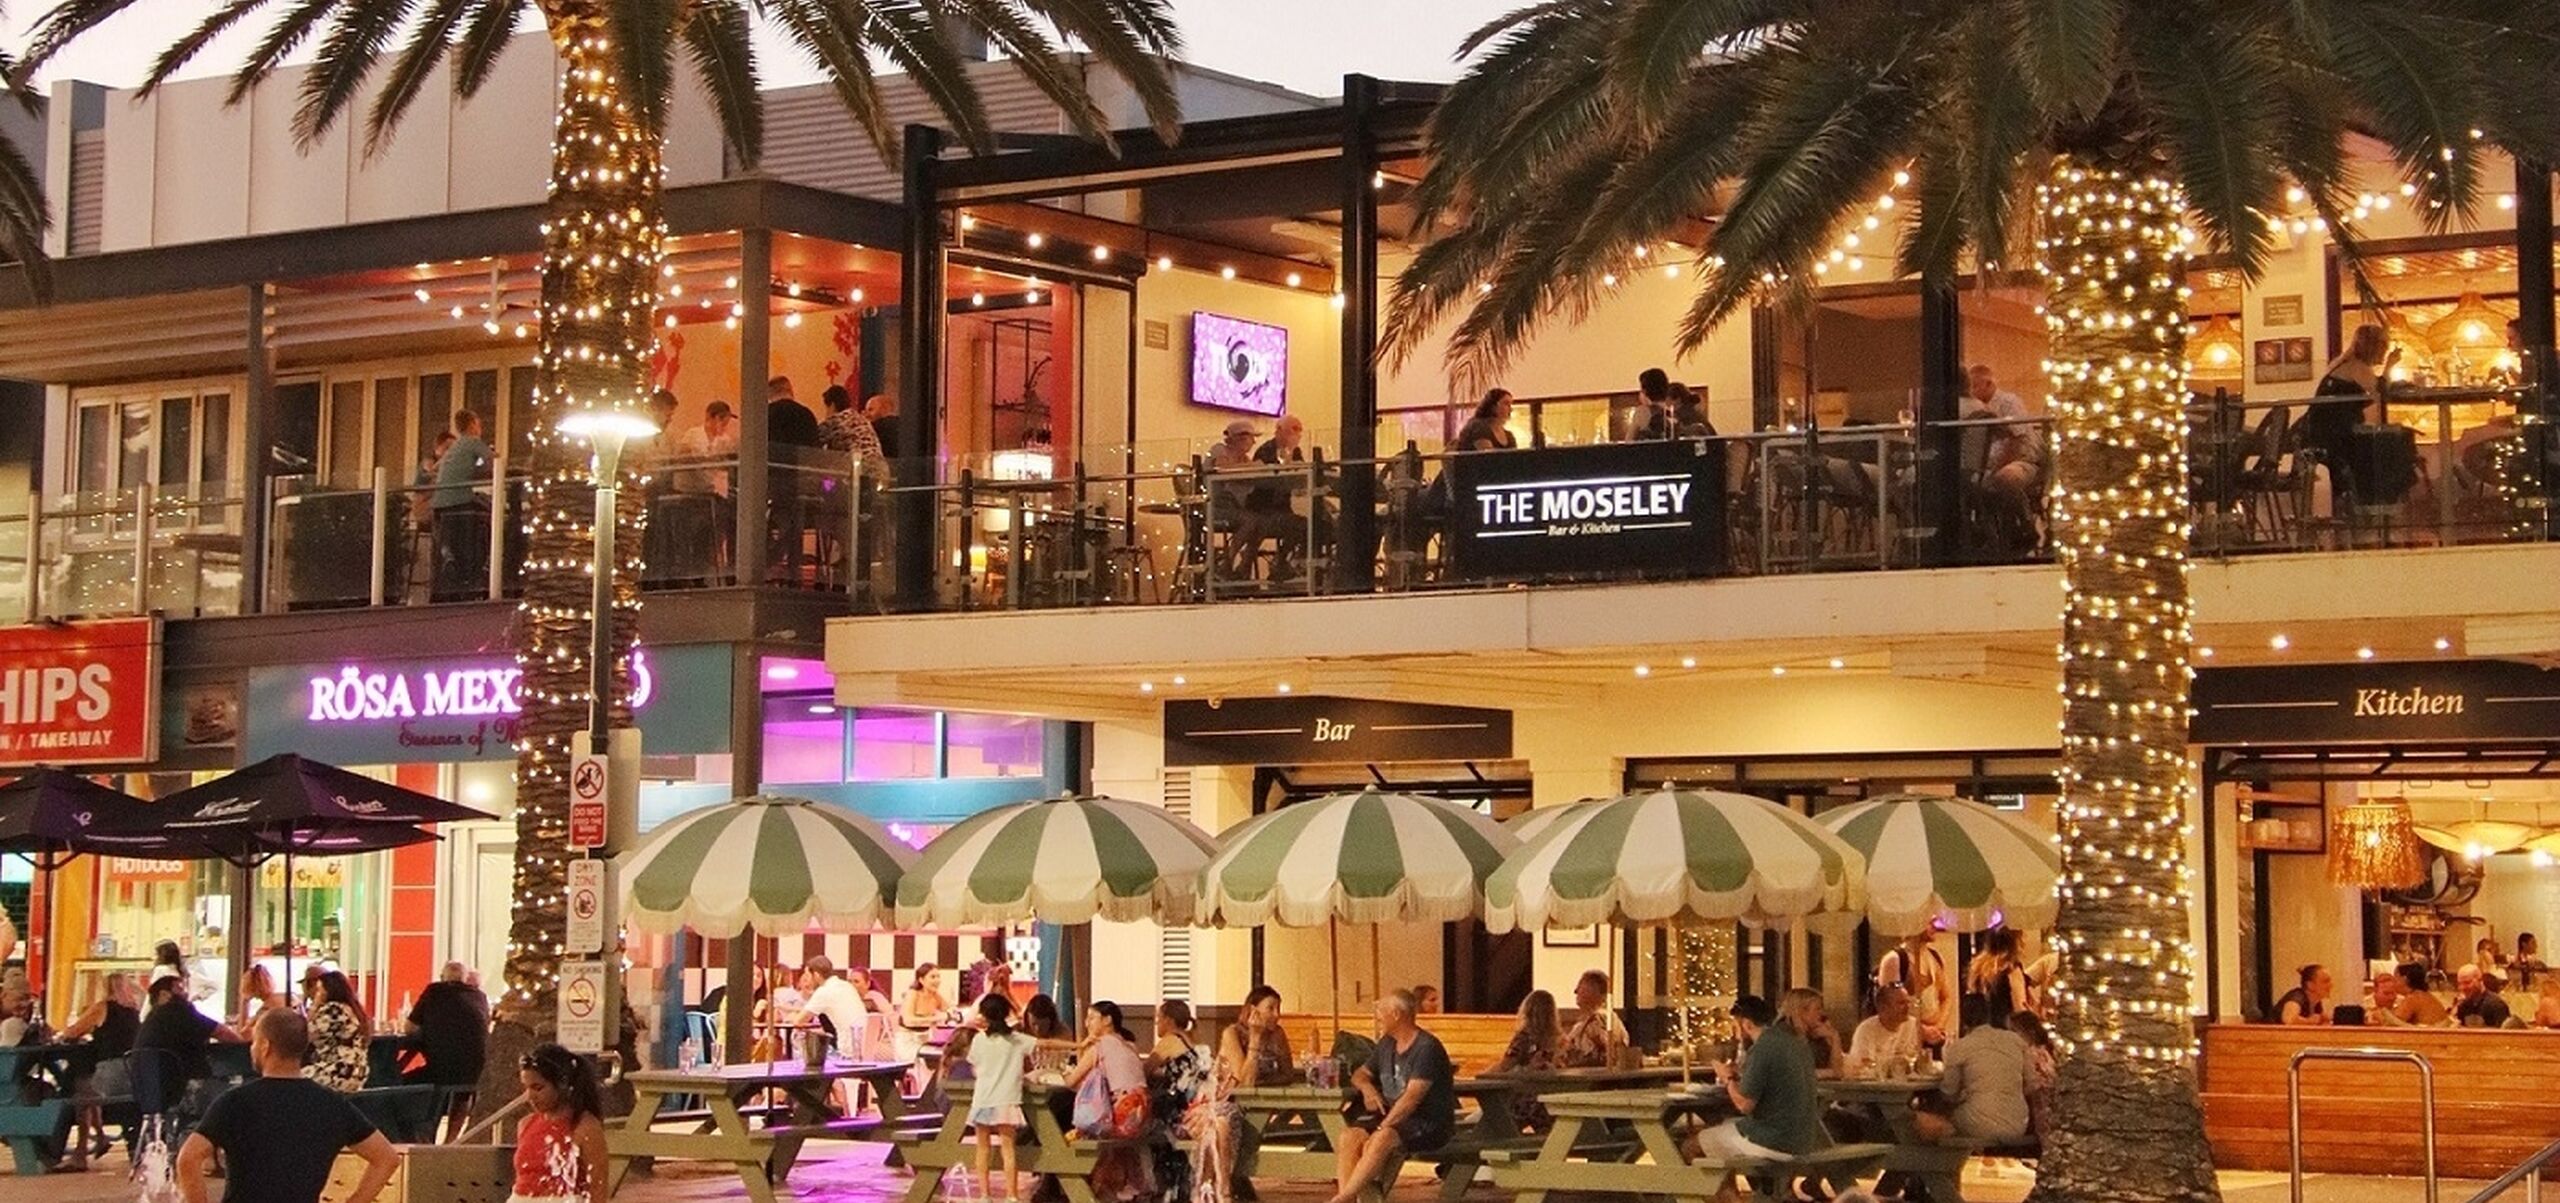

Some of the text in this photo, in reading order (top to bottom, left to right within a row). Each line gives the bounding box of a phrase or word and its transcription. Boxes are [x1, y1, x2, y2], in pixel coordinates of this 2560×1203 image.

[1477, 483, 1690, 524] THE MOSELEY
[1548, 521, 1621, 536] Bar & Kitchen
[2354, 687, 2465, 717] Kitchen
[30, 729, 113, 748] TAKEAWAY
[468, 721, 486, 755] of
[1313, 718, 1355, 742] Bar
